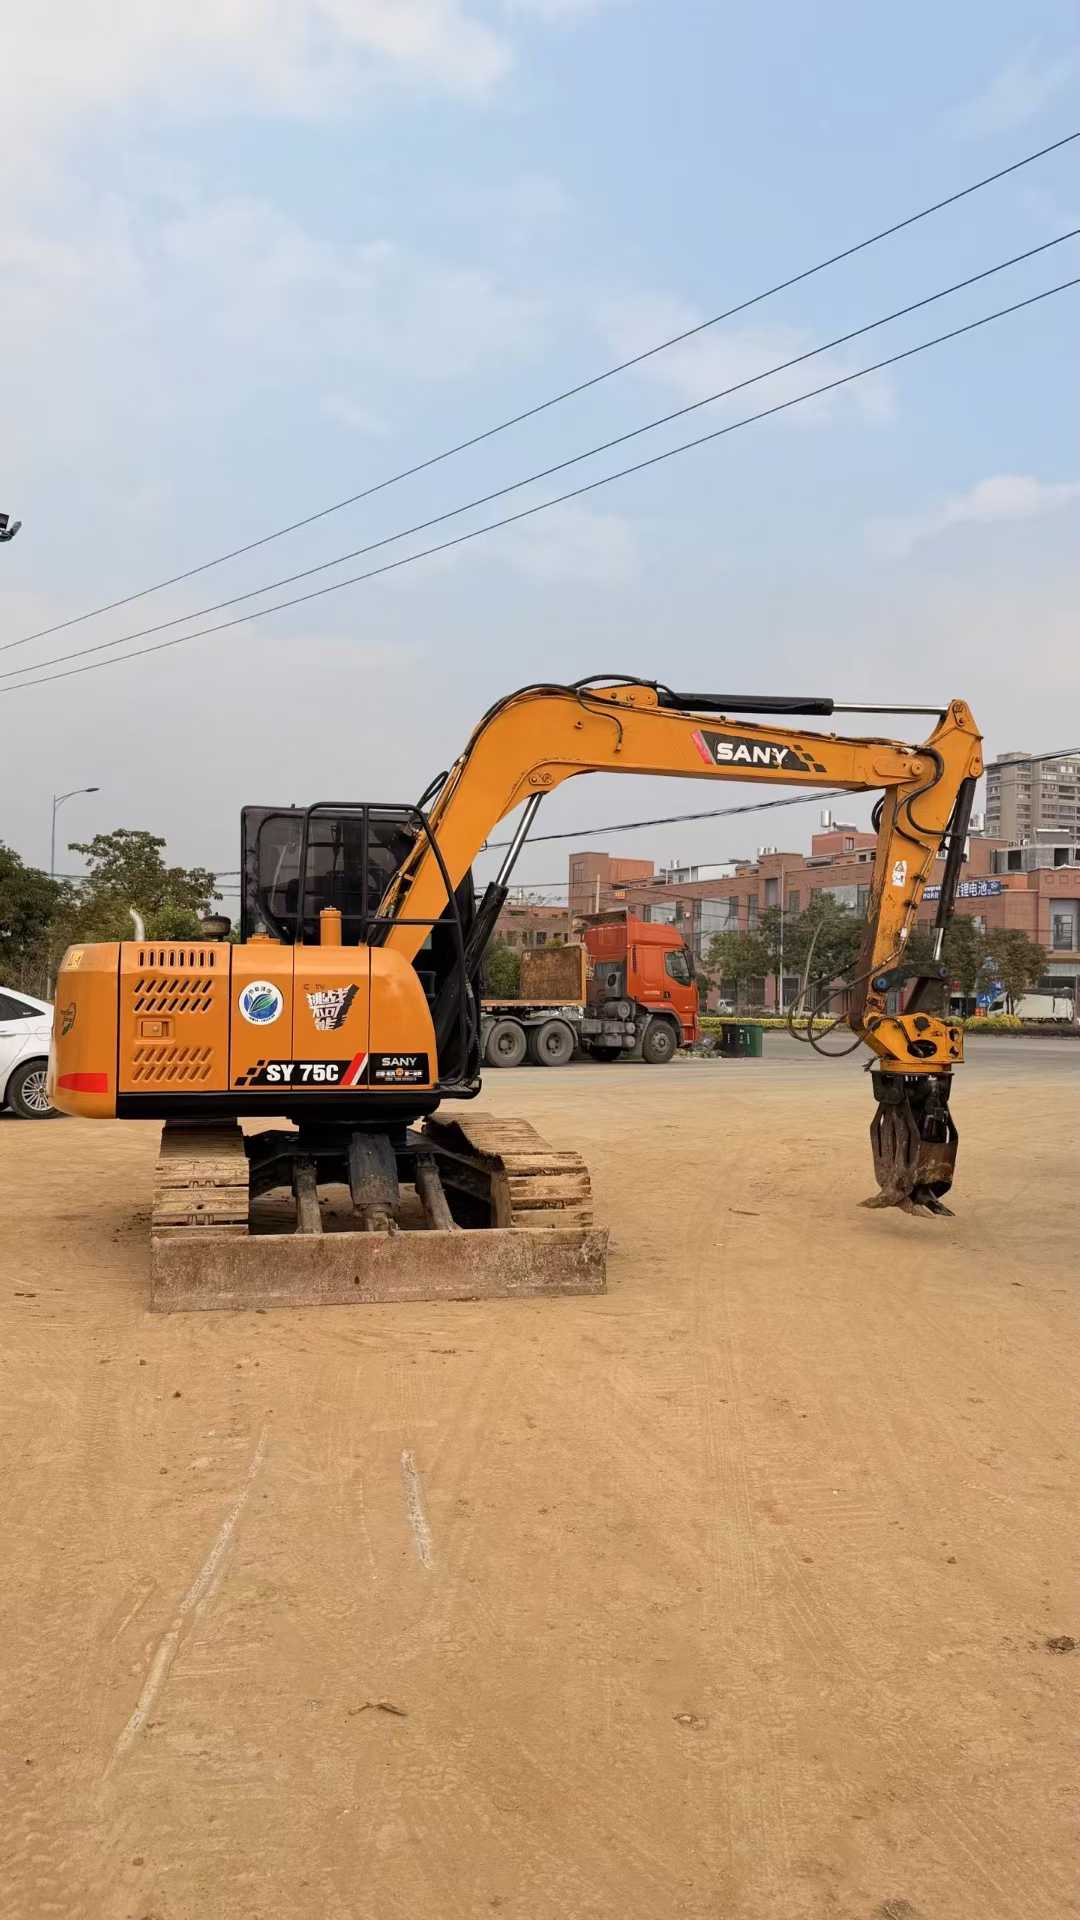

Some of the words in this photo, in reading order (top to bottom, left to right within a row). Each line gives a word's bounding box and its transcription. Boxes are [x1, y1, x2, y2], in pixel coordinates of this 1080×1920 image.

[716, 742, 789, 765] SANY
[955, 881, 988, 898] 锂电池
[306, 988, 349, 1005] 挑战
[310, 1002, 344, 1019] 不可
[381, 1056, 417, 1067] SANY
[266, 1064, 294, 1082] SY
[300, 1064, 339, 1082] 75C
